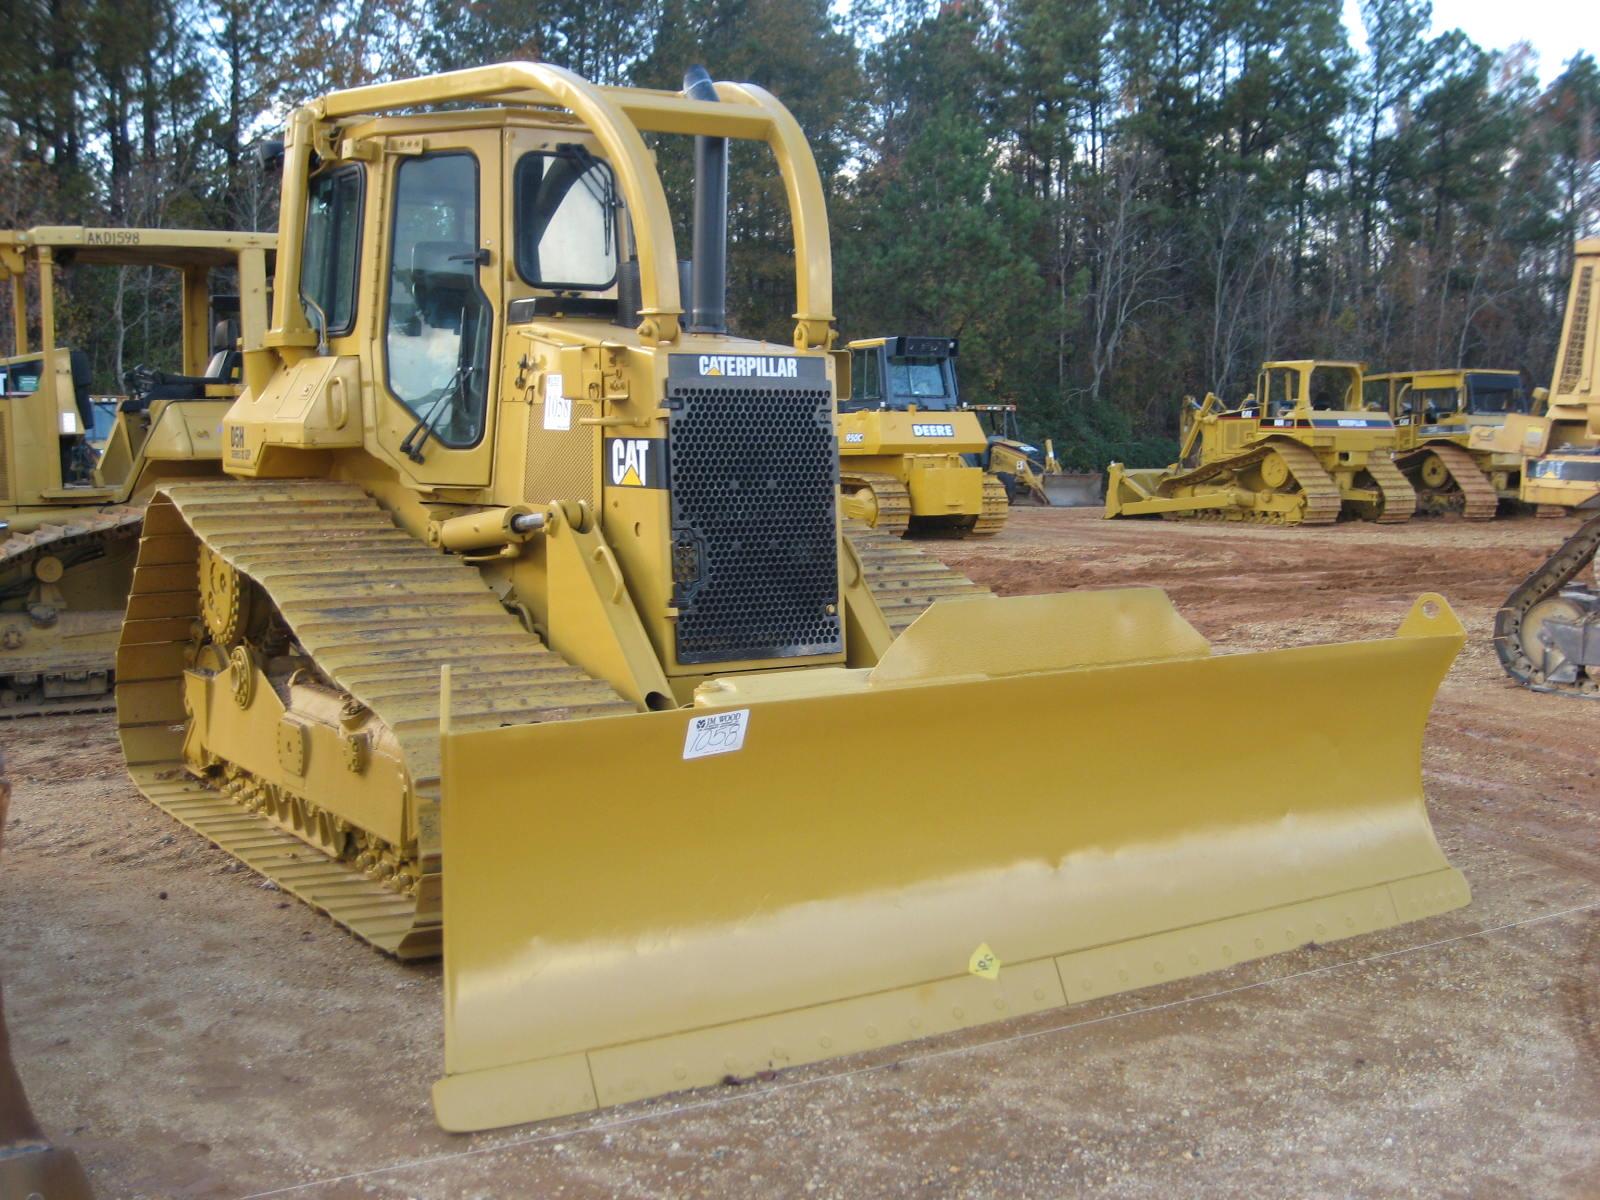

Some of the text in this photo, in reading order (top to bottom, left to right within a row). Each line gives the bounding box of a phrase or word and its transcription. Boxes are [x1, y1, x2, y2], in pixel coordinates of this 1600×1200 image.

[699, 355, 798, 377] CATERPILLAR
[912, 424, 954, 437] DEERE
[612, 438, 649, 487] CAT
